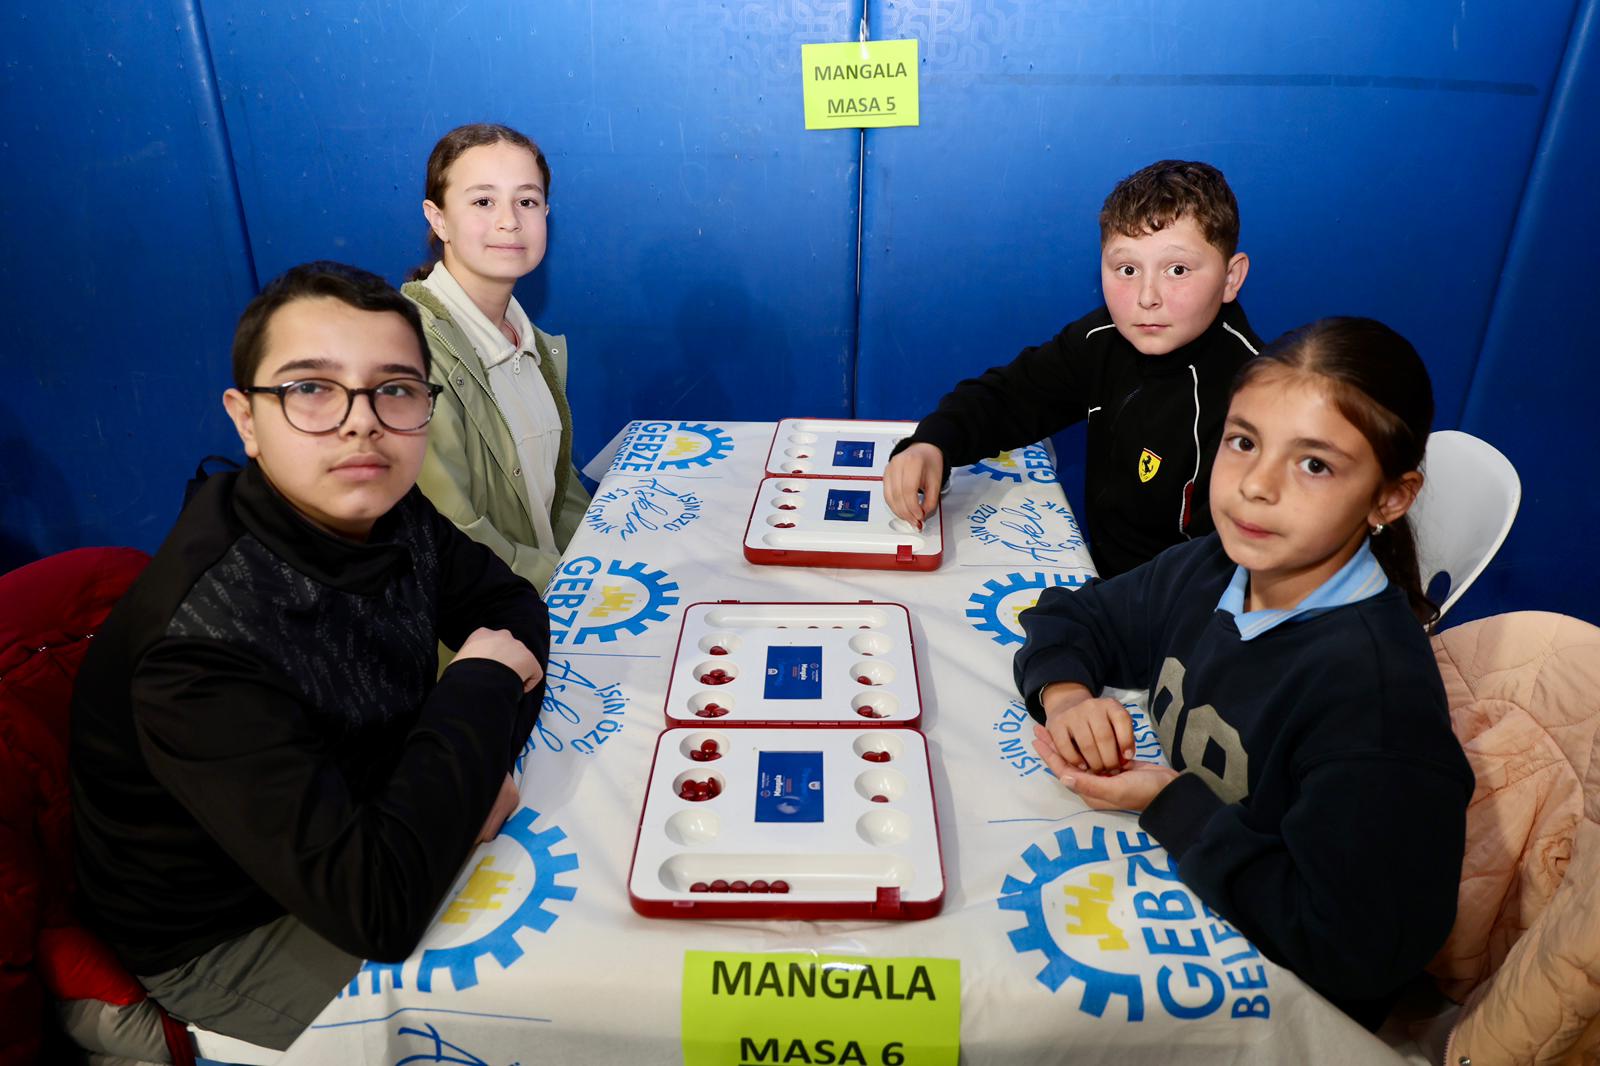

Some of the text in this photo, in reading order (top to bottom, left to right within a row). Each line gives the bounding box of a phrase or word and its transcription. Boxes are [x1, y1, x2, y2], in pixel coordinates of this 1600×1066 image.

[814, 62, 908, 81] MANGALA
[827, 96, 896, 114] MASA 5
[619, 421, 674, 472] GEBZE
[1022, 442, 1060, 484] GEB
[663, 511, 701, 532] ÖZÜ
[966, 503, 998, 524] ÖZÜ
[570, 719, 624, 755] ÖZÜ
[711, 960, 937, 1002] MANGALA
[739, 1037, 906, 1066] MASA 6
